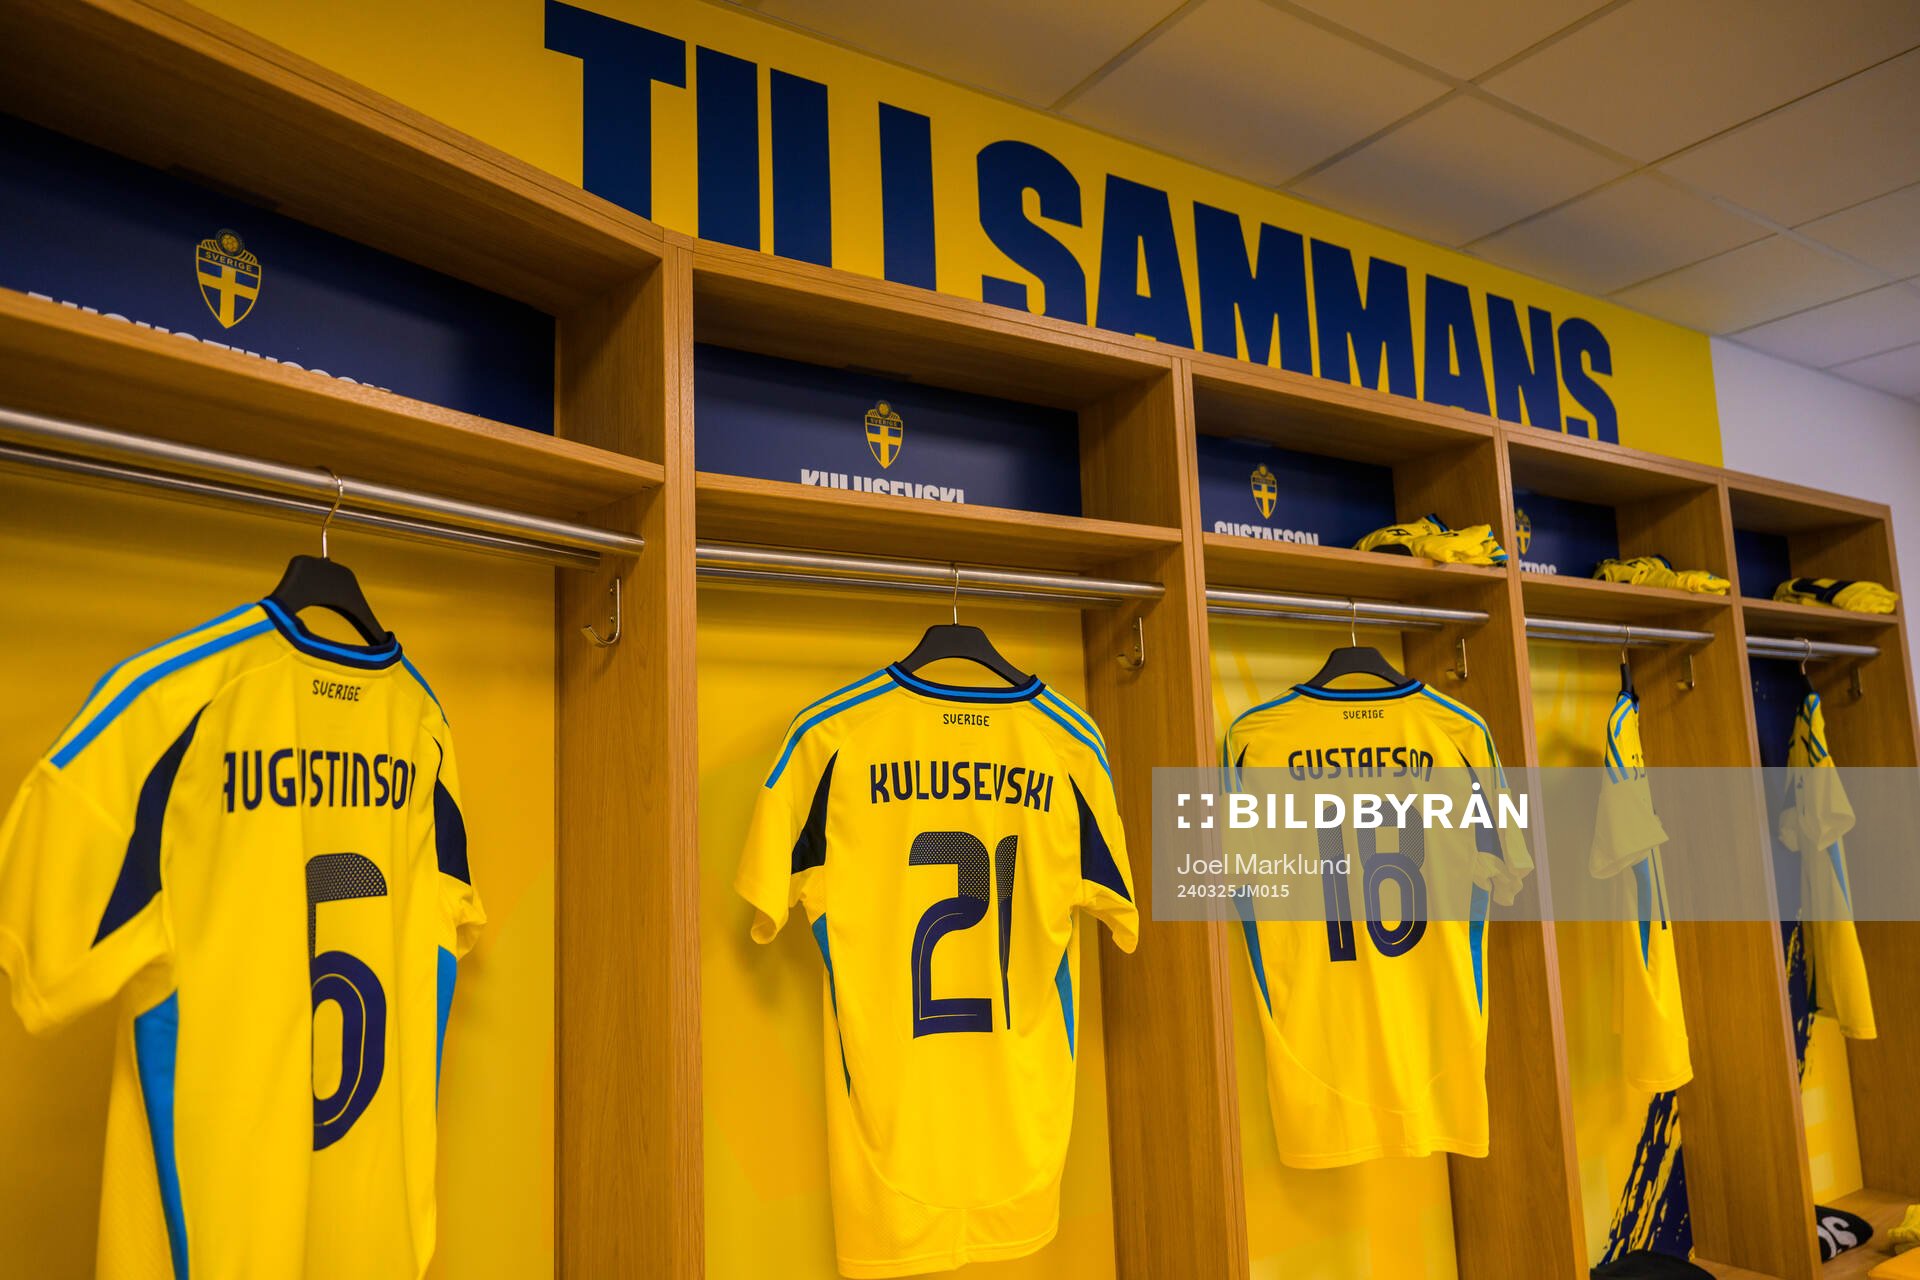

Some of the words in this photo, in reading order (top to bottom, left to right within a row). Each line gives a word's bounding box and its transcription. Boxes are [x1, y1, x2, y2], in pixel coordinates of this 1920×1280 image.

[206, 251, 253, 272] SVERIGE
[312, 680, 362, 702] SVERIGE
[943, 713, 990, 727] SVERIGE
[1343, 709, 1384, 720] SVERIGE
[1288, 747, 1433, 782] GUSTAFSON
[870, 760, 1054, 813] KULUSEVSKI
[1317, 800, 1428, 962] 18
[909, 831, 1018, 1039] 21
